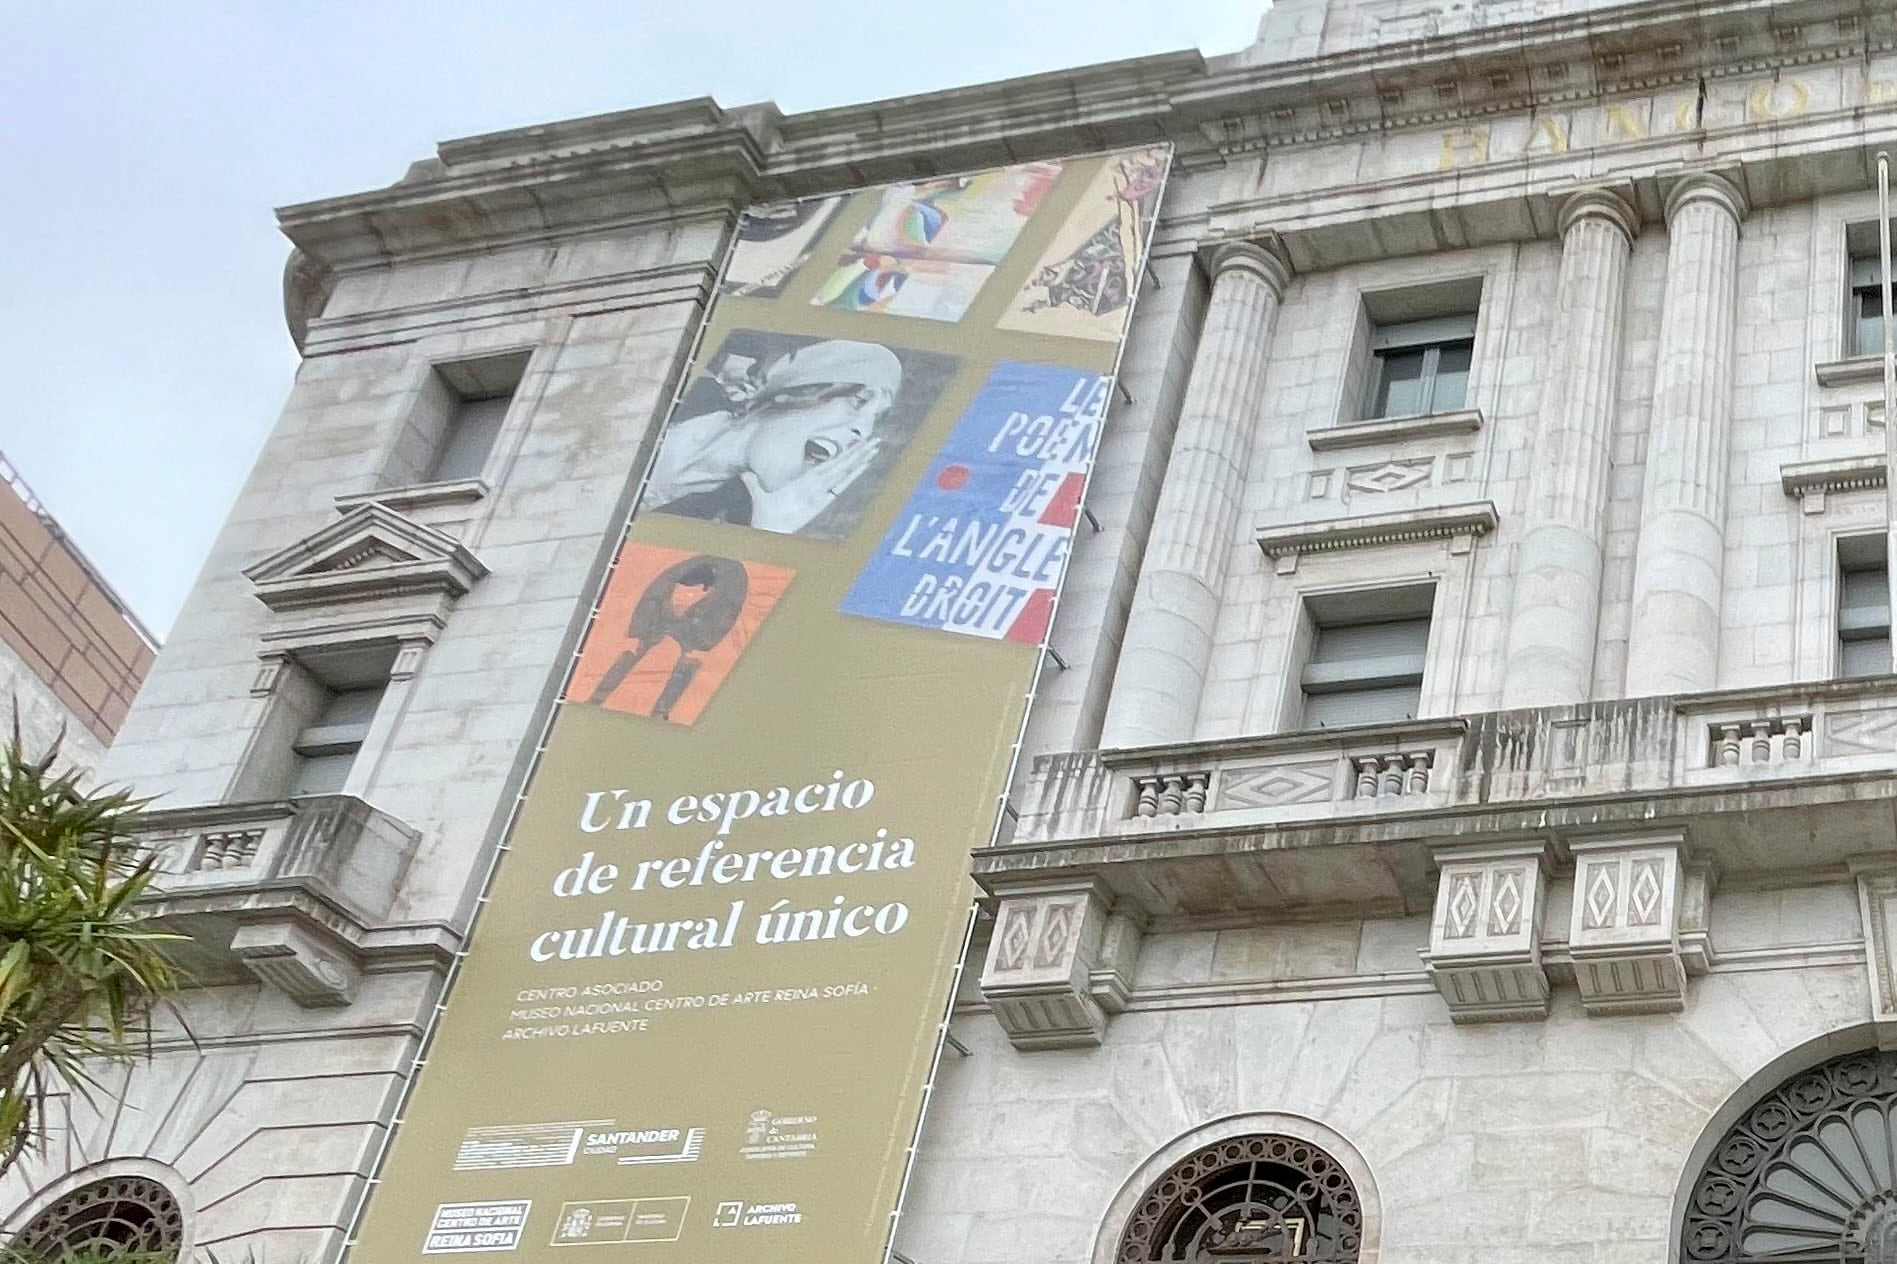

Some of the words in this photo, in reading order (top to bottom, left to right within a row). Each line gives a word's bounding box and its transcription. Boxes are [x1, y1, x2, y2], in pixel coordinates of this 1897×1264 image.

[1439, 76, 1808, 172] BANCO
[1000, 468, 1060, 518] DE
[890, 513, 1071, 582] L'ANGLE
[900, 573, 1028, 630] DROIT
[578, 789, 652, 832] Un
[667, 769, 875, 835] espacio
[552, 851, 618, 897] de
[630, 828, 916, 891] referencia
[530, 900, 744, 962] cultural
[755, 895, 909, 946] único
[510, 1006, 561, 1021] MUSEO
[563, 1001, 639, 1017] NACIONAL
[644, 995, 704, 1011] CENTRO
[708, 993, 730, 1007] DE
[731, 990, 772, 1004] ARTE
[774, 987, 819, 1001] REINA
[516, 985, 577, 1002] CENTRO
[581, 979, 664, 997] ASOCIADO
[501, 1024, 569, 1041] ARCHIVO
[571, 1018, 650, 1036] LAFUENTE
[586, 1129, 680, 1146] SANTANDER
[743, 1213, 803, 1226] LAFUENTE
[747, 1203, 797, 1214] ARCHIVO
[429, 1234, 472, 1248] REINA
